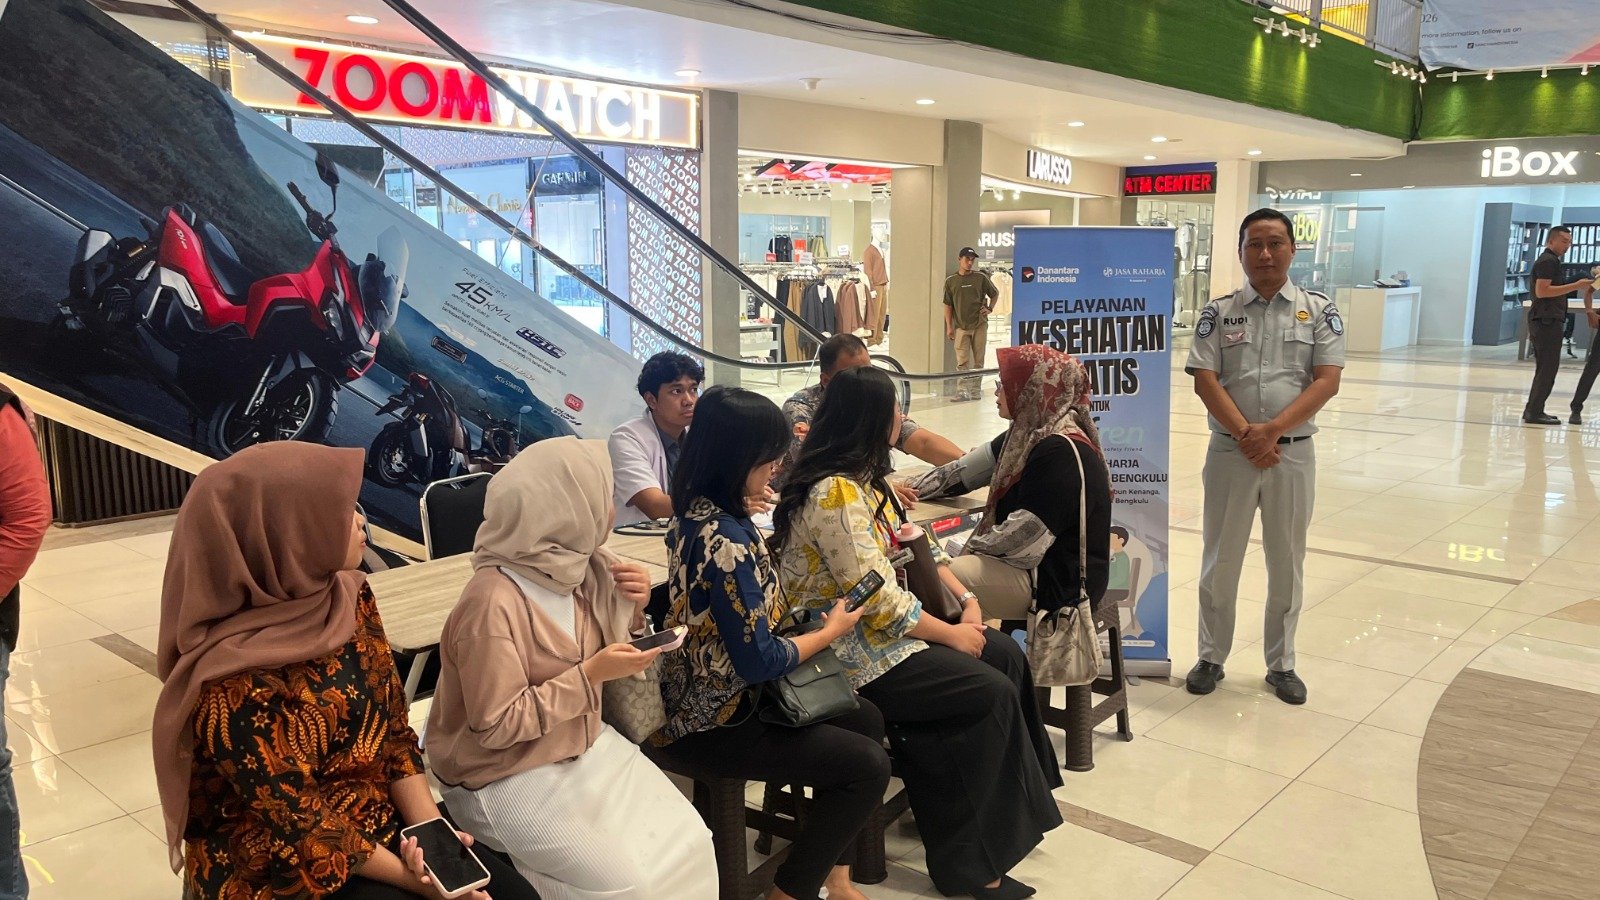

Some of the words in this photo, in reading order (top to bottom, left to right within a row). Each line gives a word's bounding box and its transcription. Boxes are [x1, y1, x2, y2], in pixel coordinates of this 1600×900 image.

[1028, 149, 1072, 185] LARUSSO
[1481, 146, 1579, 178] iBox
[1124, 176, 1152, 193] ATM
[1154, 173, 1212, 192] CENTER
[1037, 266, 1081, 275] Danantara
[1115, 267, 1131, 277] JASA
[1133, 267, 1166, 277] RAHARJA
[1037, 275, 1077, 283] Indonesia
[455, 283, 493, 305] 45
[1041, 297, 1146, 315] PELAYANAN
[1223, 316, 1248, 326] RUDI
[1018, 314, 1166, 355] KESEHATAN
[1084, 357, 1140, 397] ATIS
[1089, 399, 1111, 412] NTUK
[1106, 459, 1139, 469] HARJA
[1111, 473, 1168, 483] BENGKULU
[1128, 488, 1161, 496] Kenanga,
[1115, 497, 1149, 505] Bengkulu
